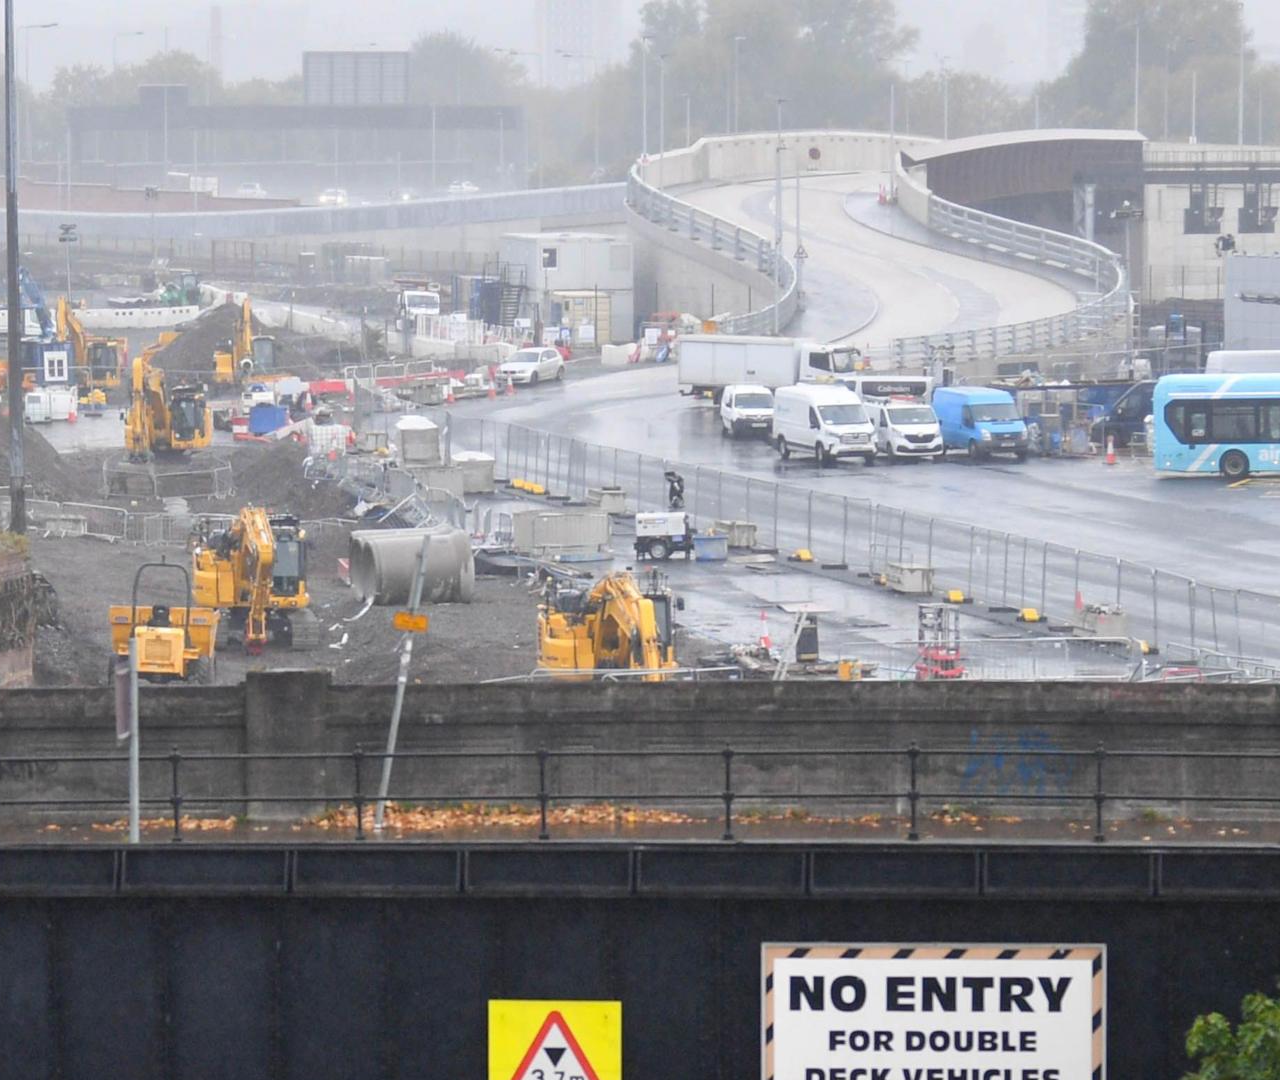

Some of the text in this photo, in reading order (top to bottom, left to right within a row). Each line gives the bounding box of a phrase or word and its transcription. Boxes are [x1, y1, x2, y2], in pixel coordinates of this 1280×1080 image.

[789, 975, 1073, 1013] NO ENTRY
[828, 1030, 1037, 1052] FOR DOUBLE
